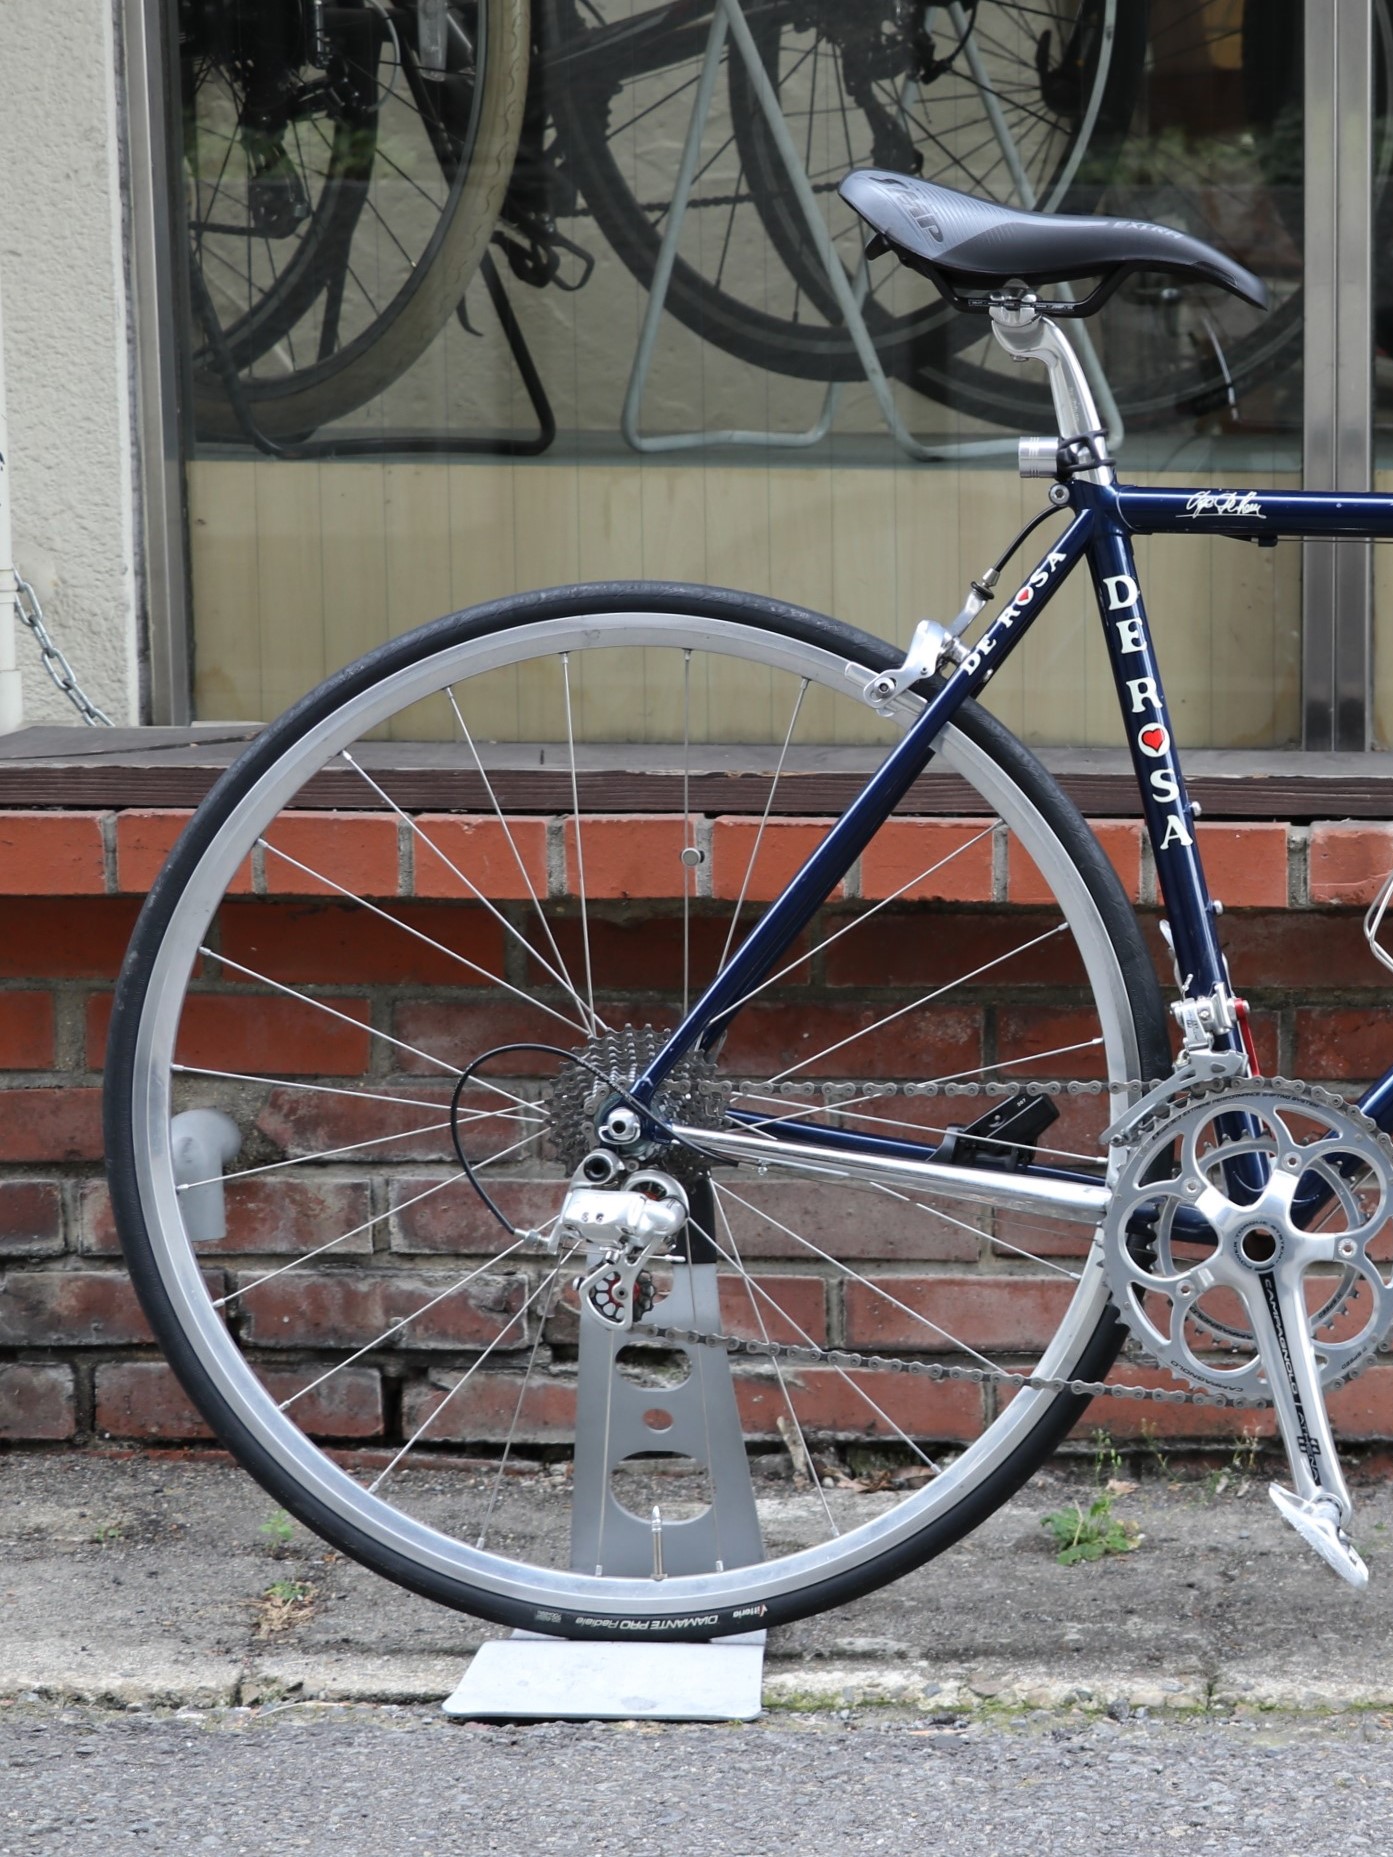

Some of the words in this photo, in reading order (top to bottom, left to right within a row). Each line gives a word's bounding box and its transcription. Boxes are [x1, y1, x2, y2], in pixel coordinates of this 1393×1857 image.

[959, 633, 997, 676] DE
[997, 551, 1067, 629] ROSA
[1102, 574, 1148, 654] DE
[1126, 676, 1194, 850] ROSA
[1264, 1278, 1299, 1394] CAMPAGNOLO
[1170, 1360, 1244, 1392] CAMPAGNOLO
[575, 1616, 618, 1630] Radiale
[619, 1619, 650, 1630] PRO
[649, 1614, 718, 1630] DIAMANTE
